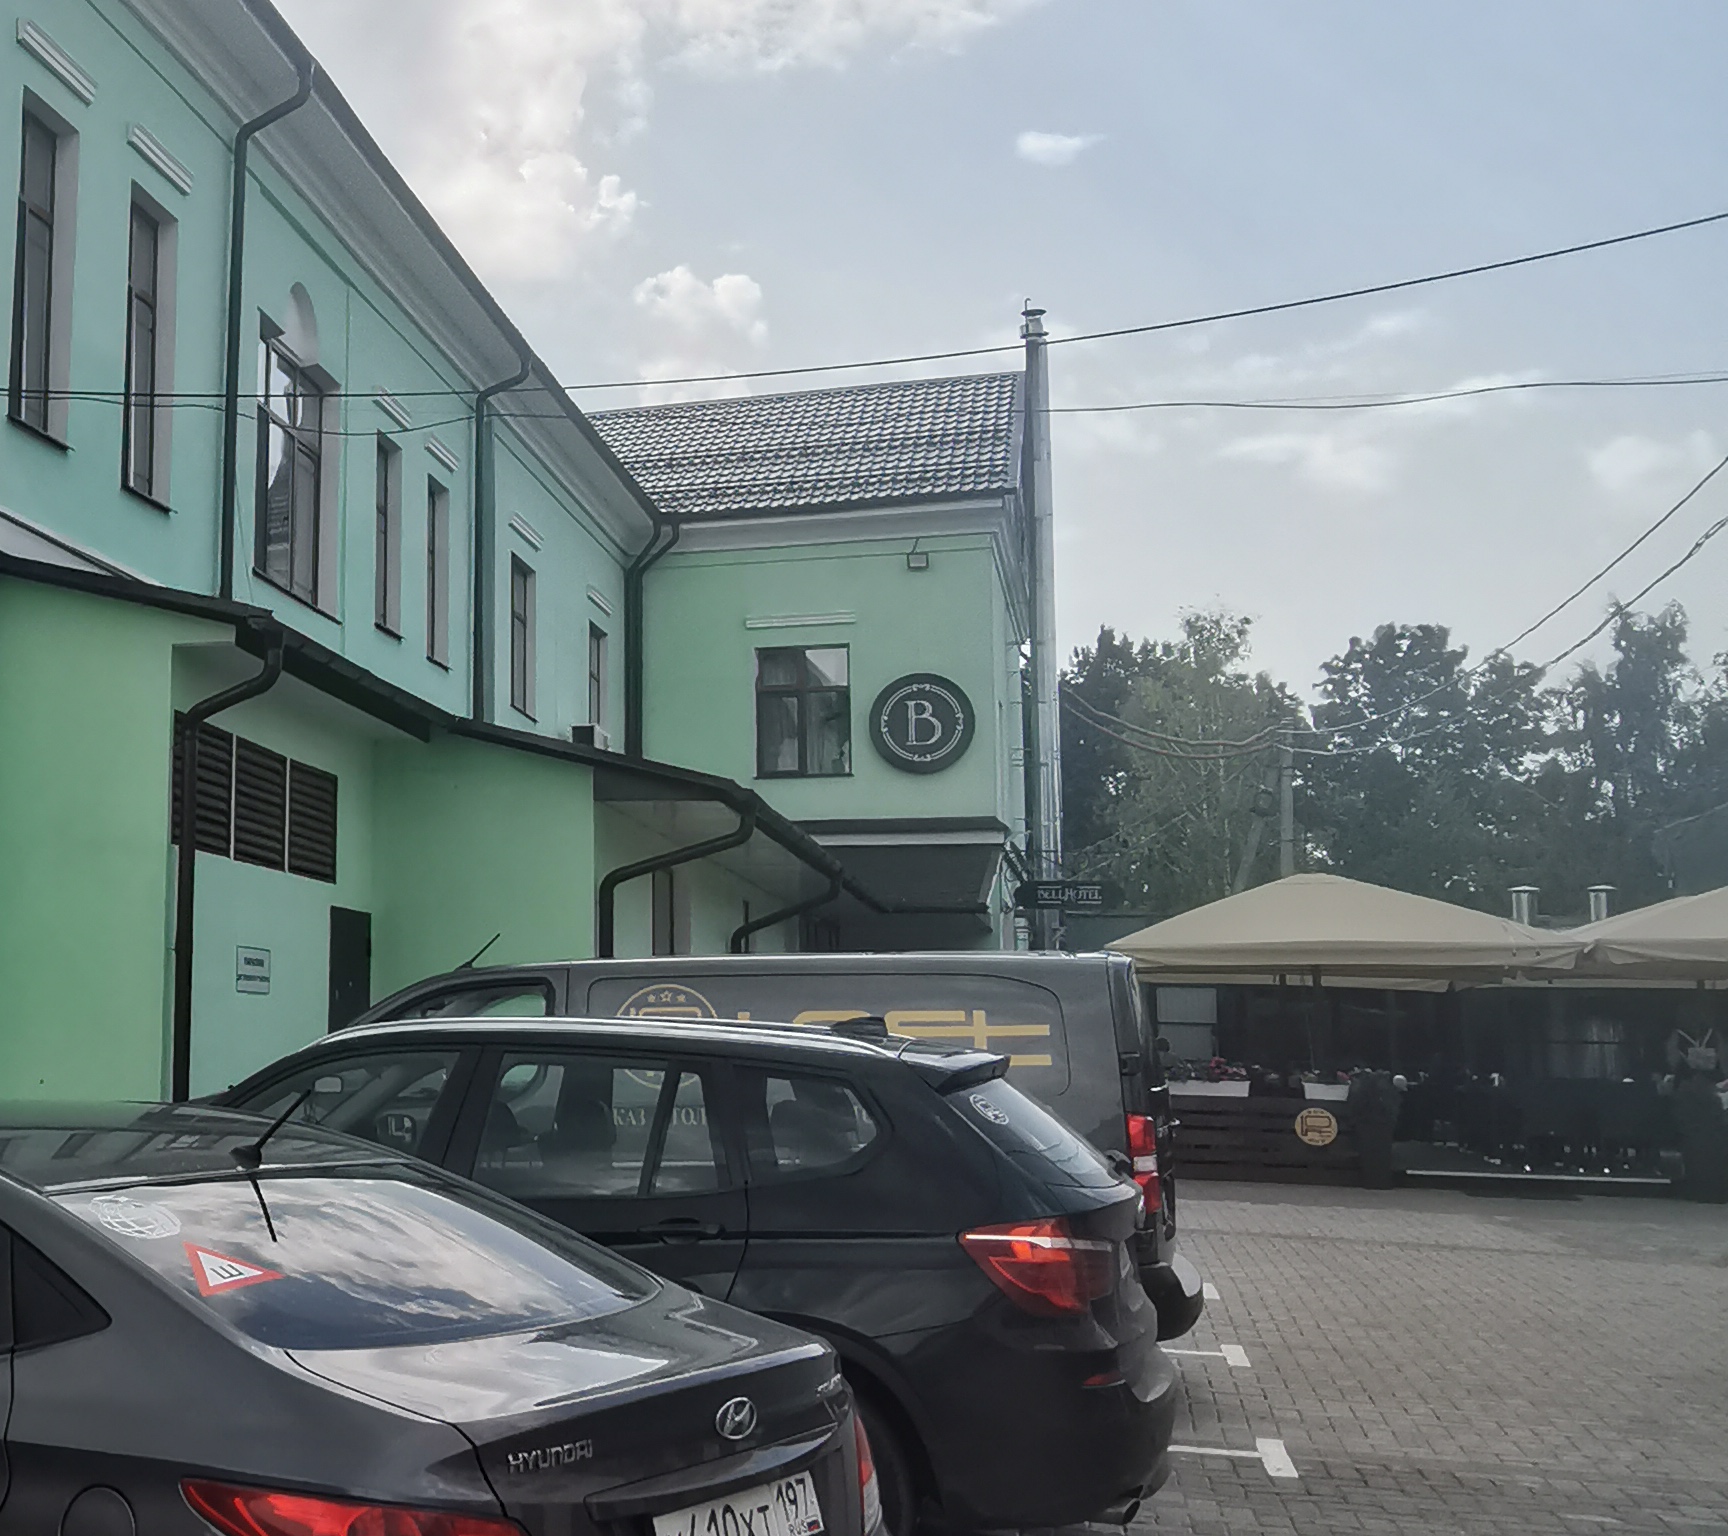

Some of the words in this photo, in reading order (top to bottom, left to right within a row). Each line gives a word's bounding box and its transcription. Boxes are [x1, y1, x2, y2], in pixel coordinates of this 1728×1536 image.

[507, 1439, 593, 1473] HYUNDAI
[775, 1477, 810, 1523] 197
[788, 1519, 809, 1536] RUS
